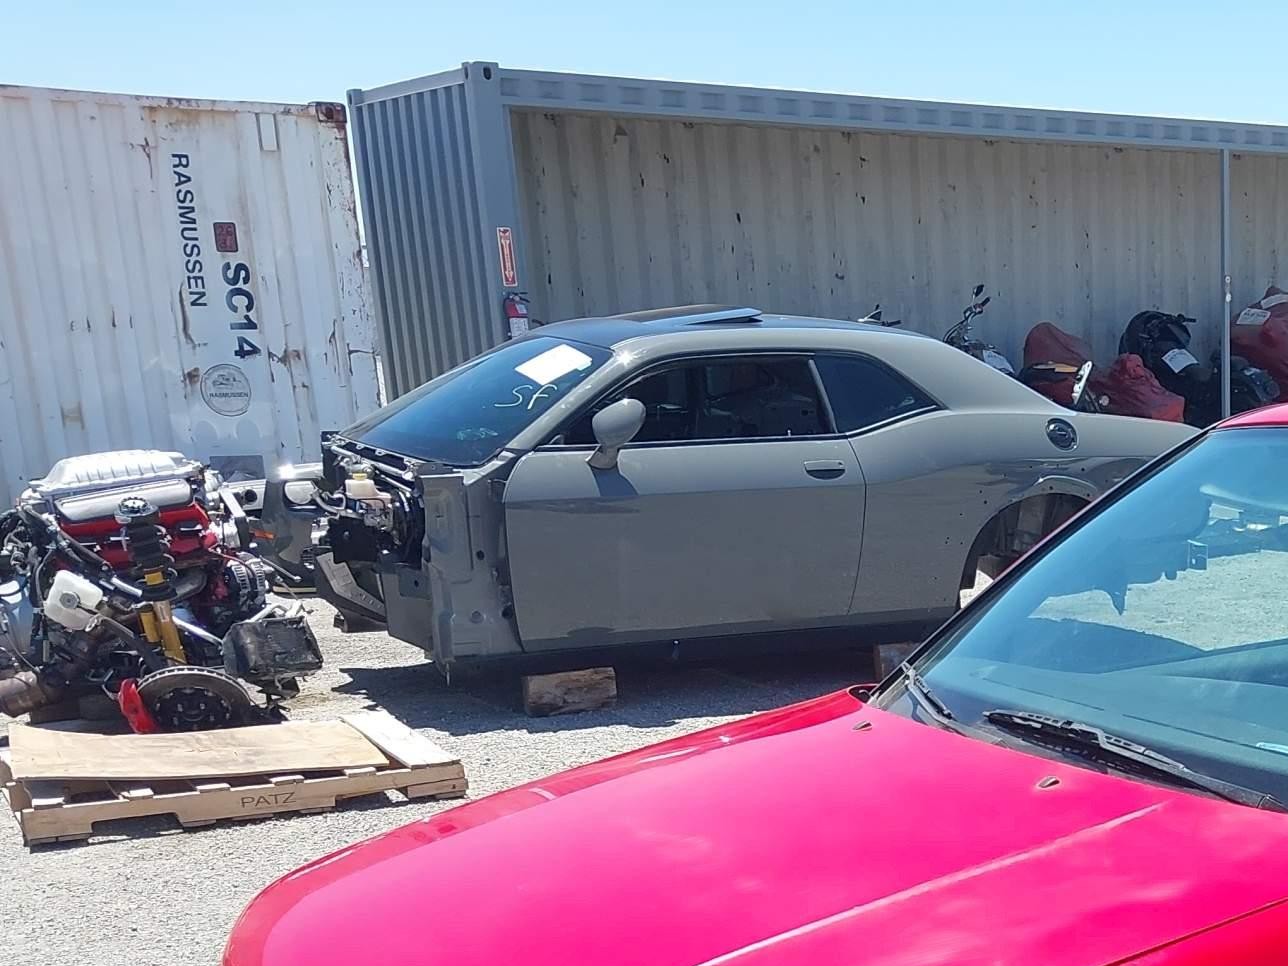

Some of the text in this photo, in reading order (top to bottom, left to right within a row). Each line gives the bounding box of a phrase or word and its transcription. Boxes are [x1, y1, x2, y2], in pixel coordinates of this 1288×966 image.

[171, 153, 208, 307] RASMUSSEN
[222, 261, 262, 359] SC14
[241, 791, 297, 808] PATZ
